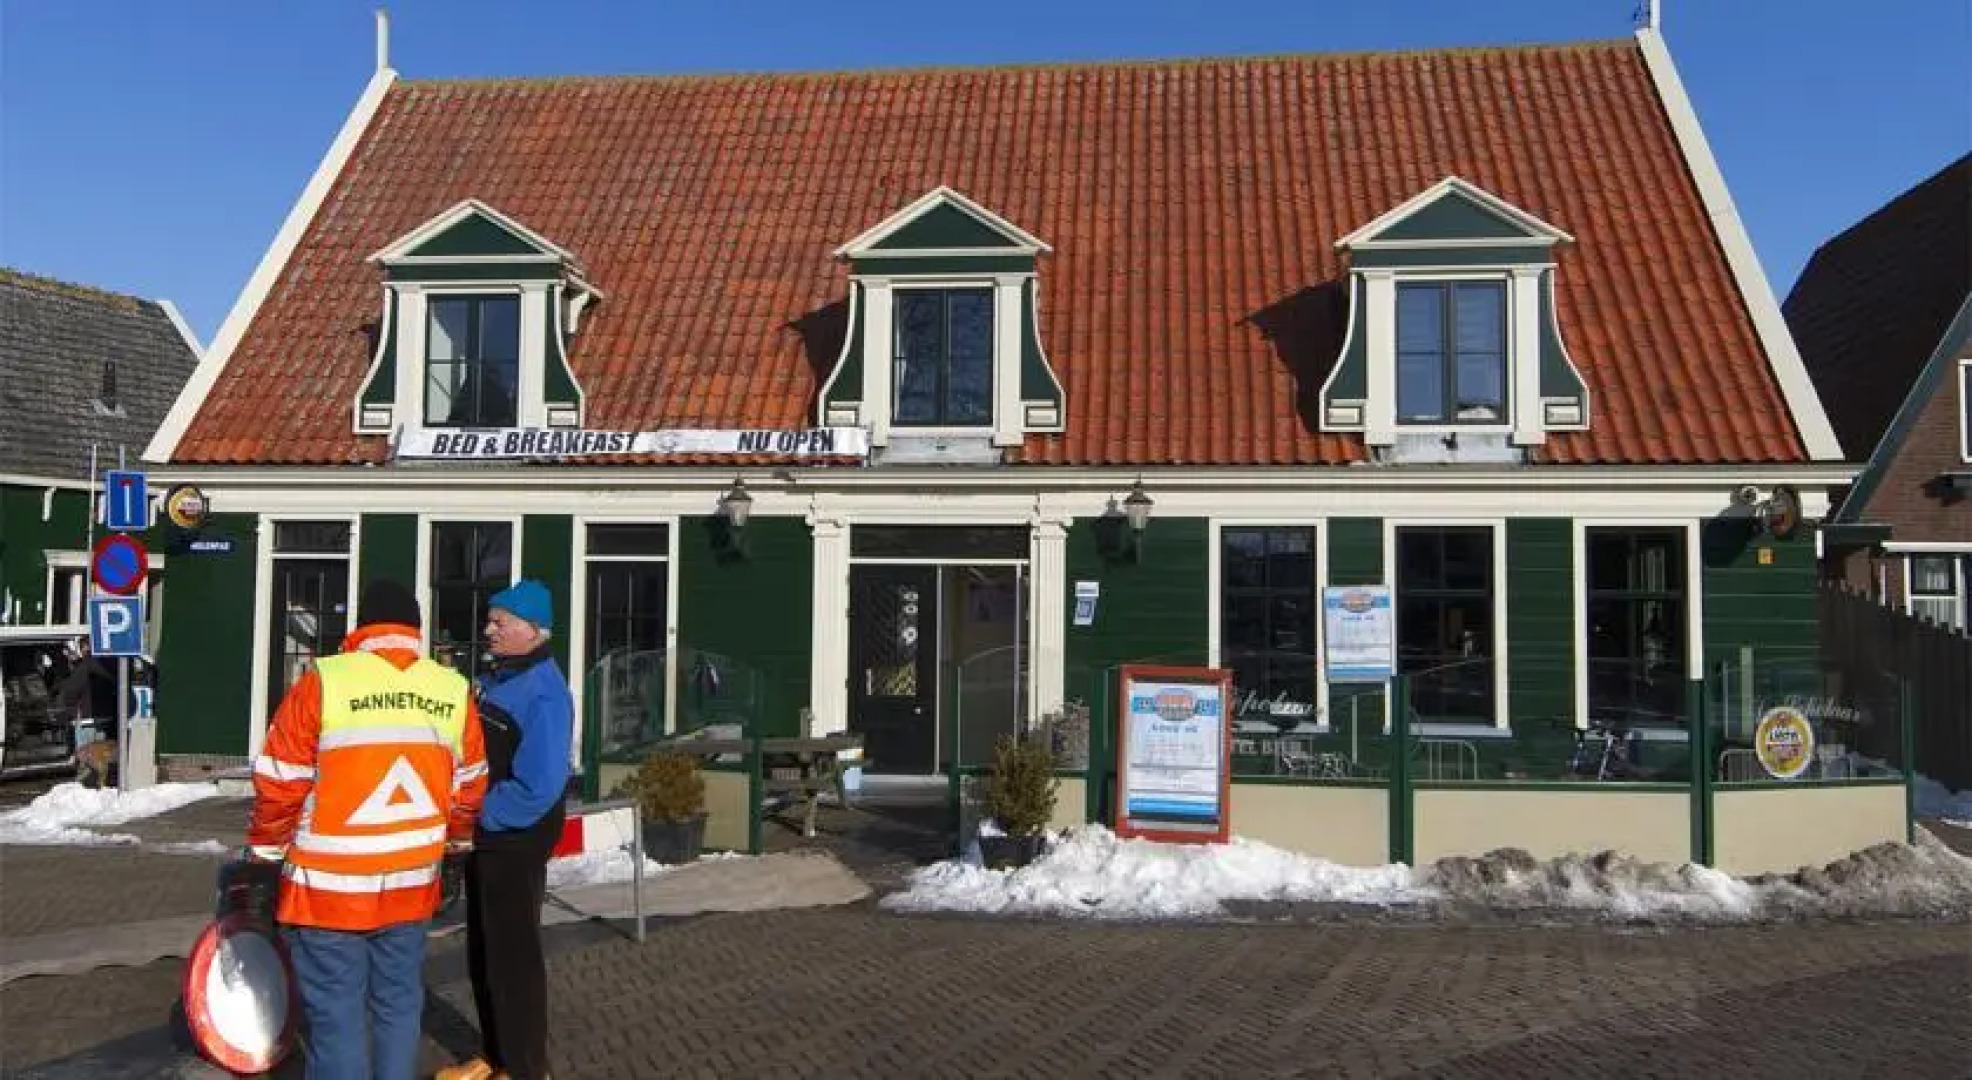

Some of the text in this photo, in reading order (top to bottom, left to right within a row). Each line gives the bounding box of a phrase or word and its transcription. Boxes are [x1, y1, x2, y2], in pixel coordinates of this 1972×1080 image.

[431, 429, 835, 454] BED & BREAKFAST NU OPEN
[99, 602, 132, 649] P
